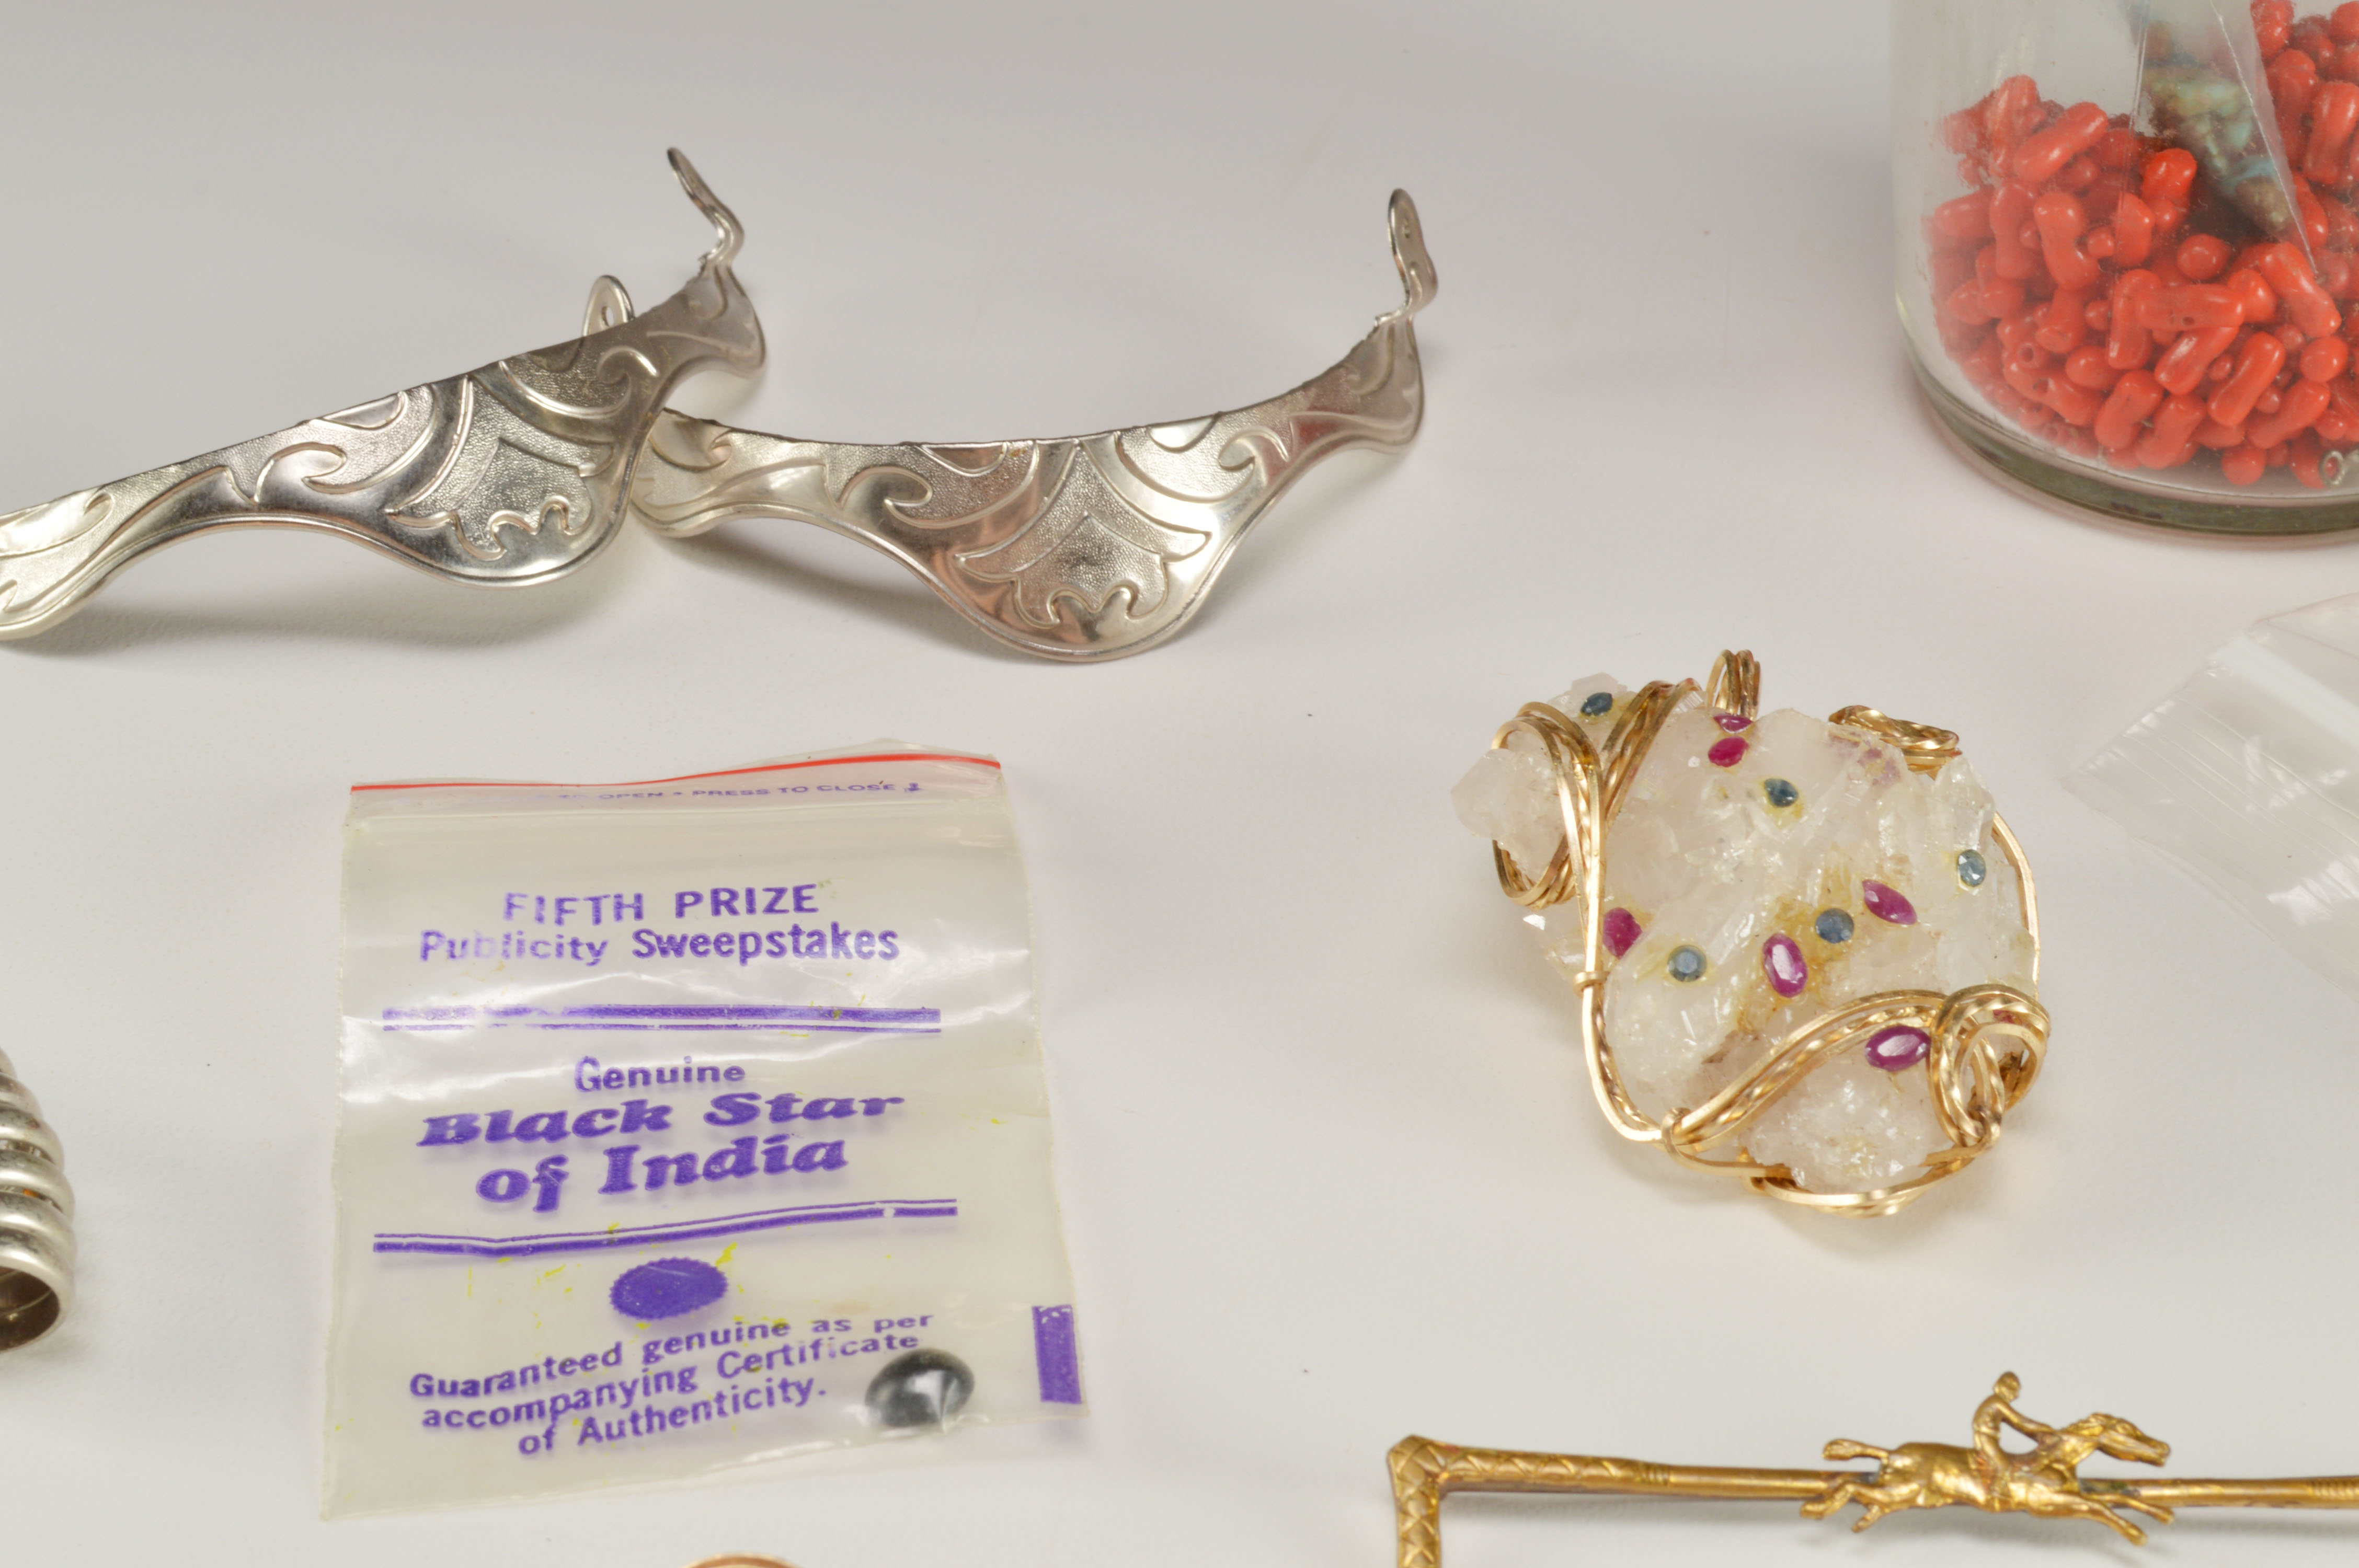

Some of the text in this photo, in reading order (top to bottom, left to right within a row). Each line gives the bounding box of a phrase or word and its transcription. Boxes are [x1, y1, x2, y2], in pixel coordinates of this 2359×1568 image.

[691, 788, 771, 798] PRESS
[778, 785, 811, 795] TO
[816, 783, 897, 793] CLOSE
[502, 883, 819, 927] FIFTH PRIZE
[420, 921, 900, 967] Publicity Sweepstakes
[575, 1056, 746, 1092] Genuine
[416, 1092, 906, 1147] Black Star
[476, 1133, 848, 1214] of India
[409, 1315, 933, 1398] Guaranteed genuine as per
[421, 1333, 919, 1429] accompanying Certificate
[519, 1374, 827, 1455] of Authenticity.
